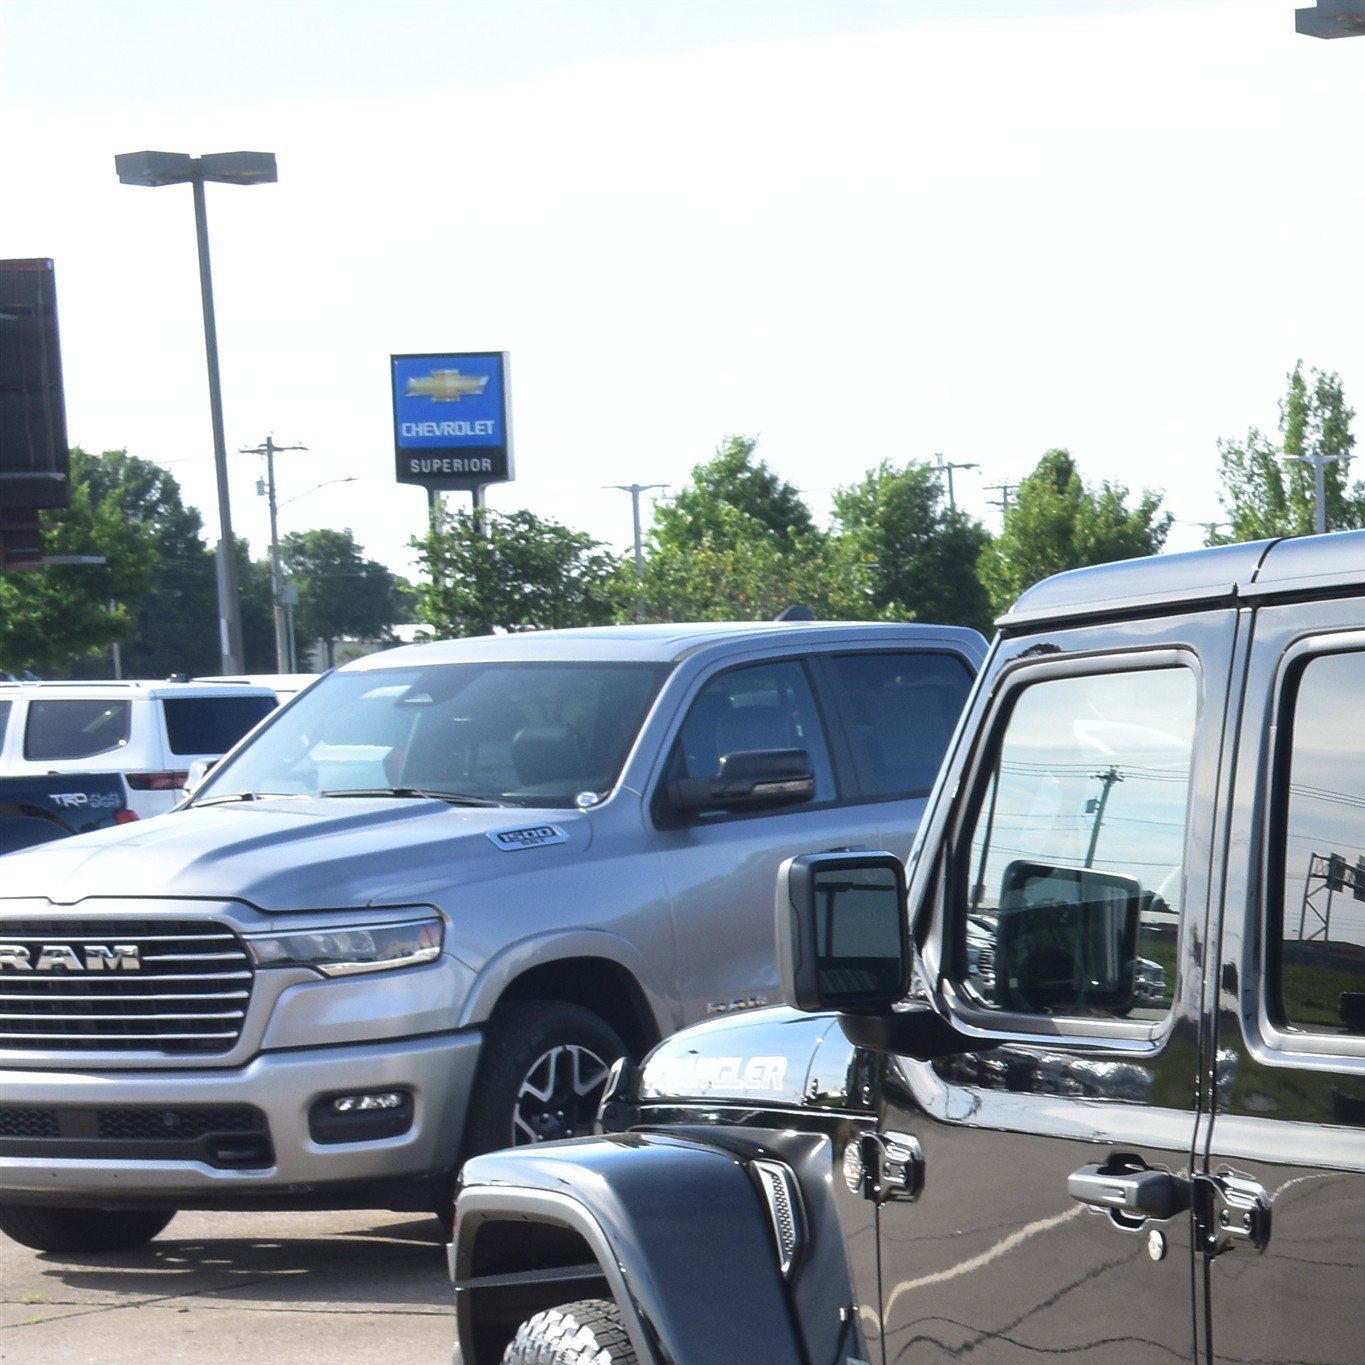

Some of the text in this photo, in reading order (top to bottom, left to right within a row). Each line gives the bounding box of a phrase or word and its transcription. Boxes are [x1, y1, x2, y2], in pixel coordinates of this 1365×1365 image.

[401, 420, 496, 437] CHEVROLET
[410, 457, 492, 473] SUPERIOR
[501, 827, 553, 843] 1500
[0, 944, 141, 970] RAM
